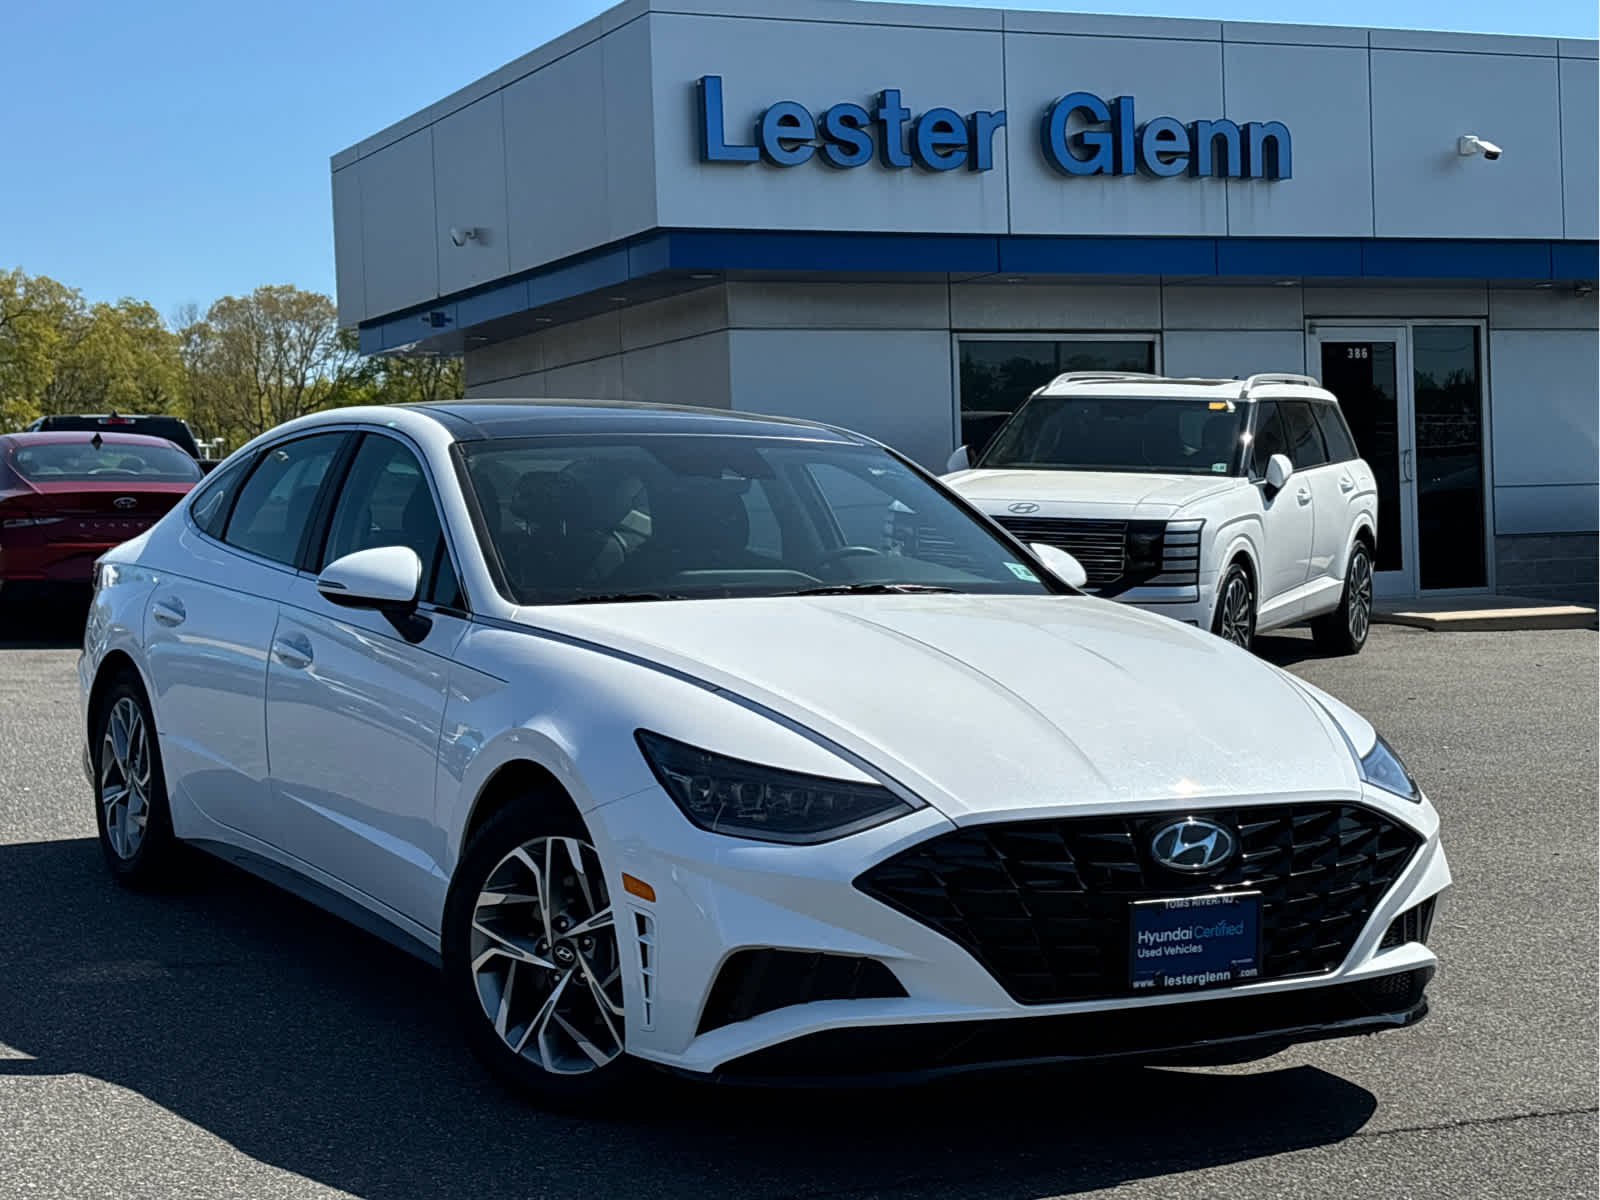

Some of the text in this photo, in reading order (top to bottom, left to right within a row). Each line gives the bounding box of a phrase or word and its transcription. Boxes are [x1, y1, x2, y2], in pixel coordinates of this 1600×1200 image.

[698, 75, 1292, 180] Lester Glenn
[1347, 347, 1368, 359] 386
[1137, 920, 1244, 946] Hyundai Certified
[1137, 943, 1203, 958] Used Vehicles
[1164, 971, 1231, 986] lesterglenn
